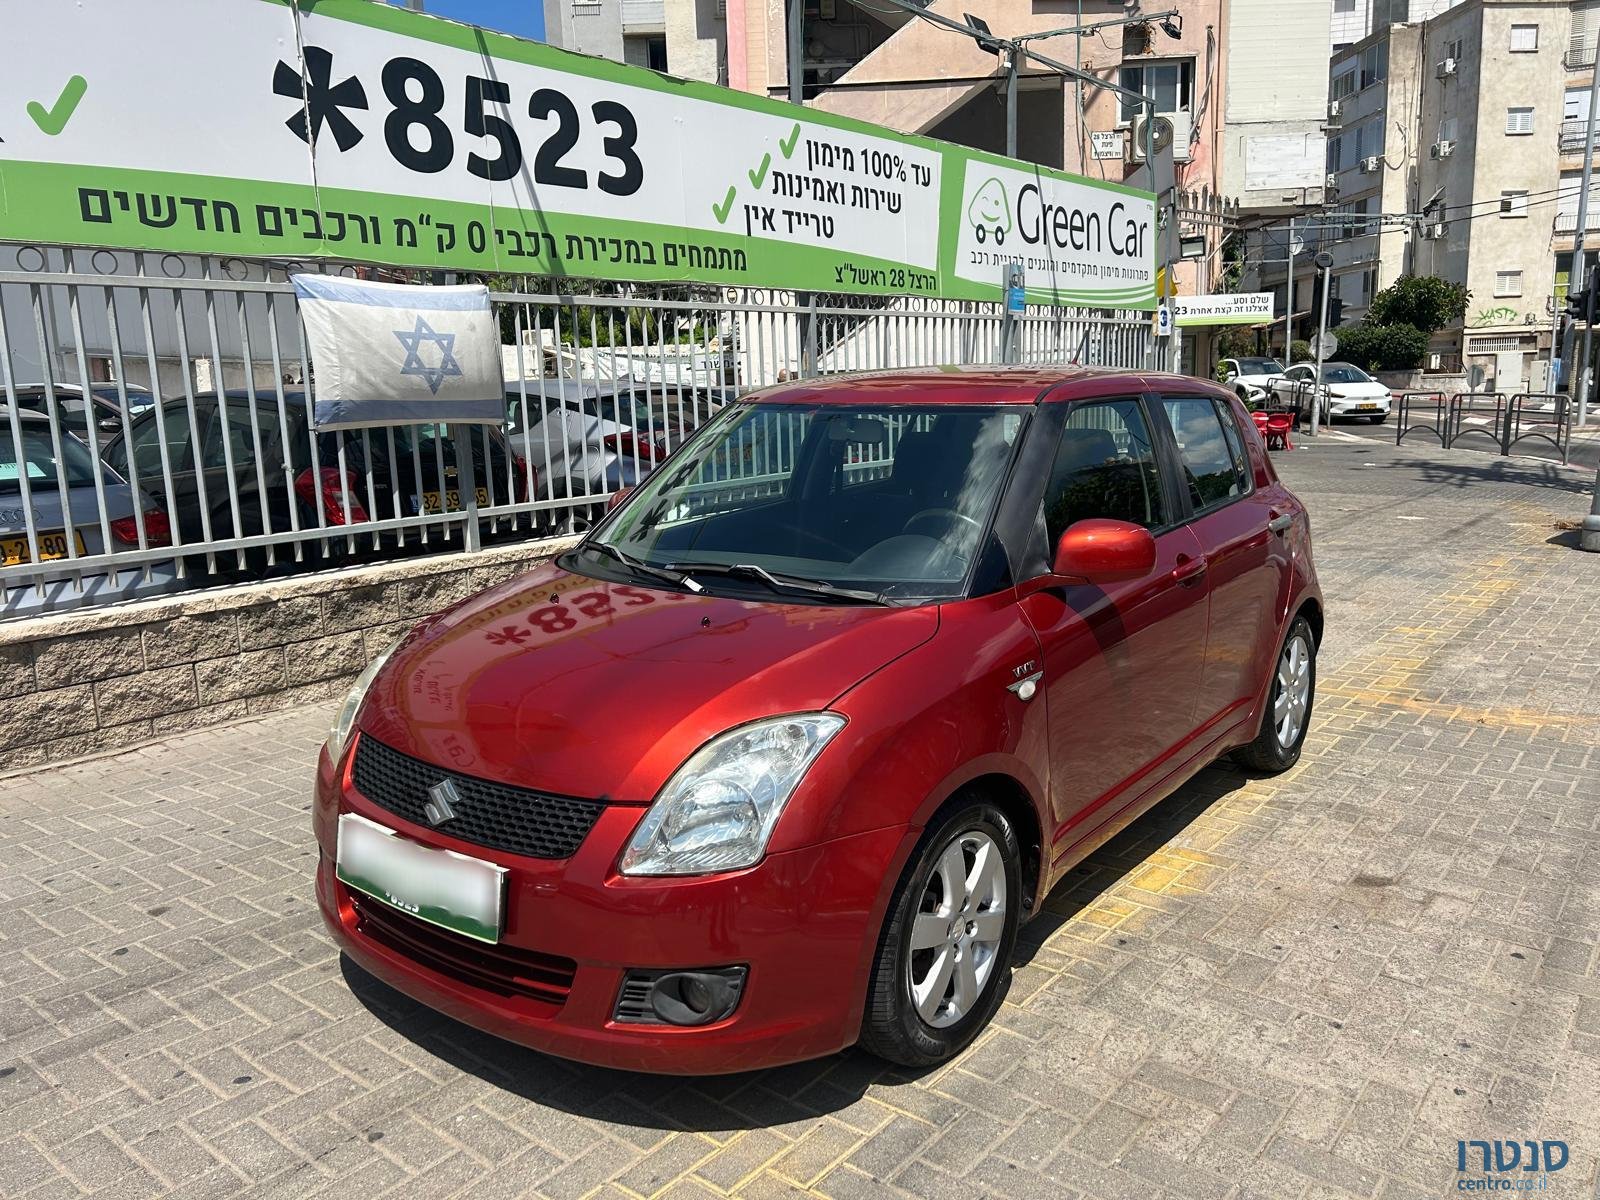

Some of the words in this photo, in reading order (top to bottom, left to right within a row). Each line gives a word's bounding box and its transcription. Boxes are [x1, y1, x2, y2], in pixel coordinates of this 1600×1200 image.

[806, 139, 855, 171] מימון
[861, 149, 907, 182] 100%
[772, 171, 846, 205] ואמינות
[911, 164, 931, 187] עד
[78, 187, 241, 234] חדשים
[851, 185, 902, 214] שירות
[256, 204, 382, 245] ורכבים
[744, 204, 776, 236] אין
[782, 209, 834, 239] טרייד
[1017, 184, 1101, 253] Green
[1108, 203, 1148, 258] Car
[467, 221, 486, 253] 0
[495, 229, 557, 258] רכבי
[565, 234, 657, 265] במכירת
[663, 243, 747, 271] מתמחים
[970, 250, 989, 266] רכב
[1061, 261, 1098, 279] מתקדמים
[889, 268, 905, 288] 28
[908, 270, 937, 291] הרצל
[1100, 265, 1119, 280] מימון
[1121, 268, 1149, 281] פתרונות
[1214, 307, 1232, 315] קצת
[1245, 305, 1269, 313] אצלנו
[1250, 296, 1269, 304] שלם
